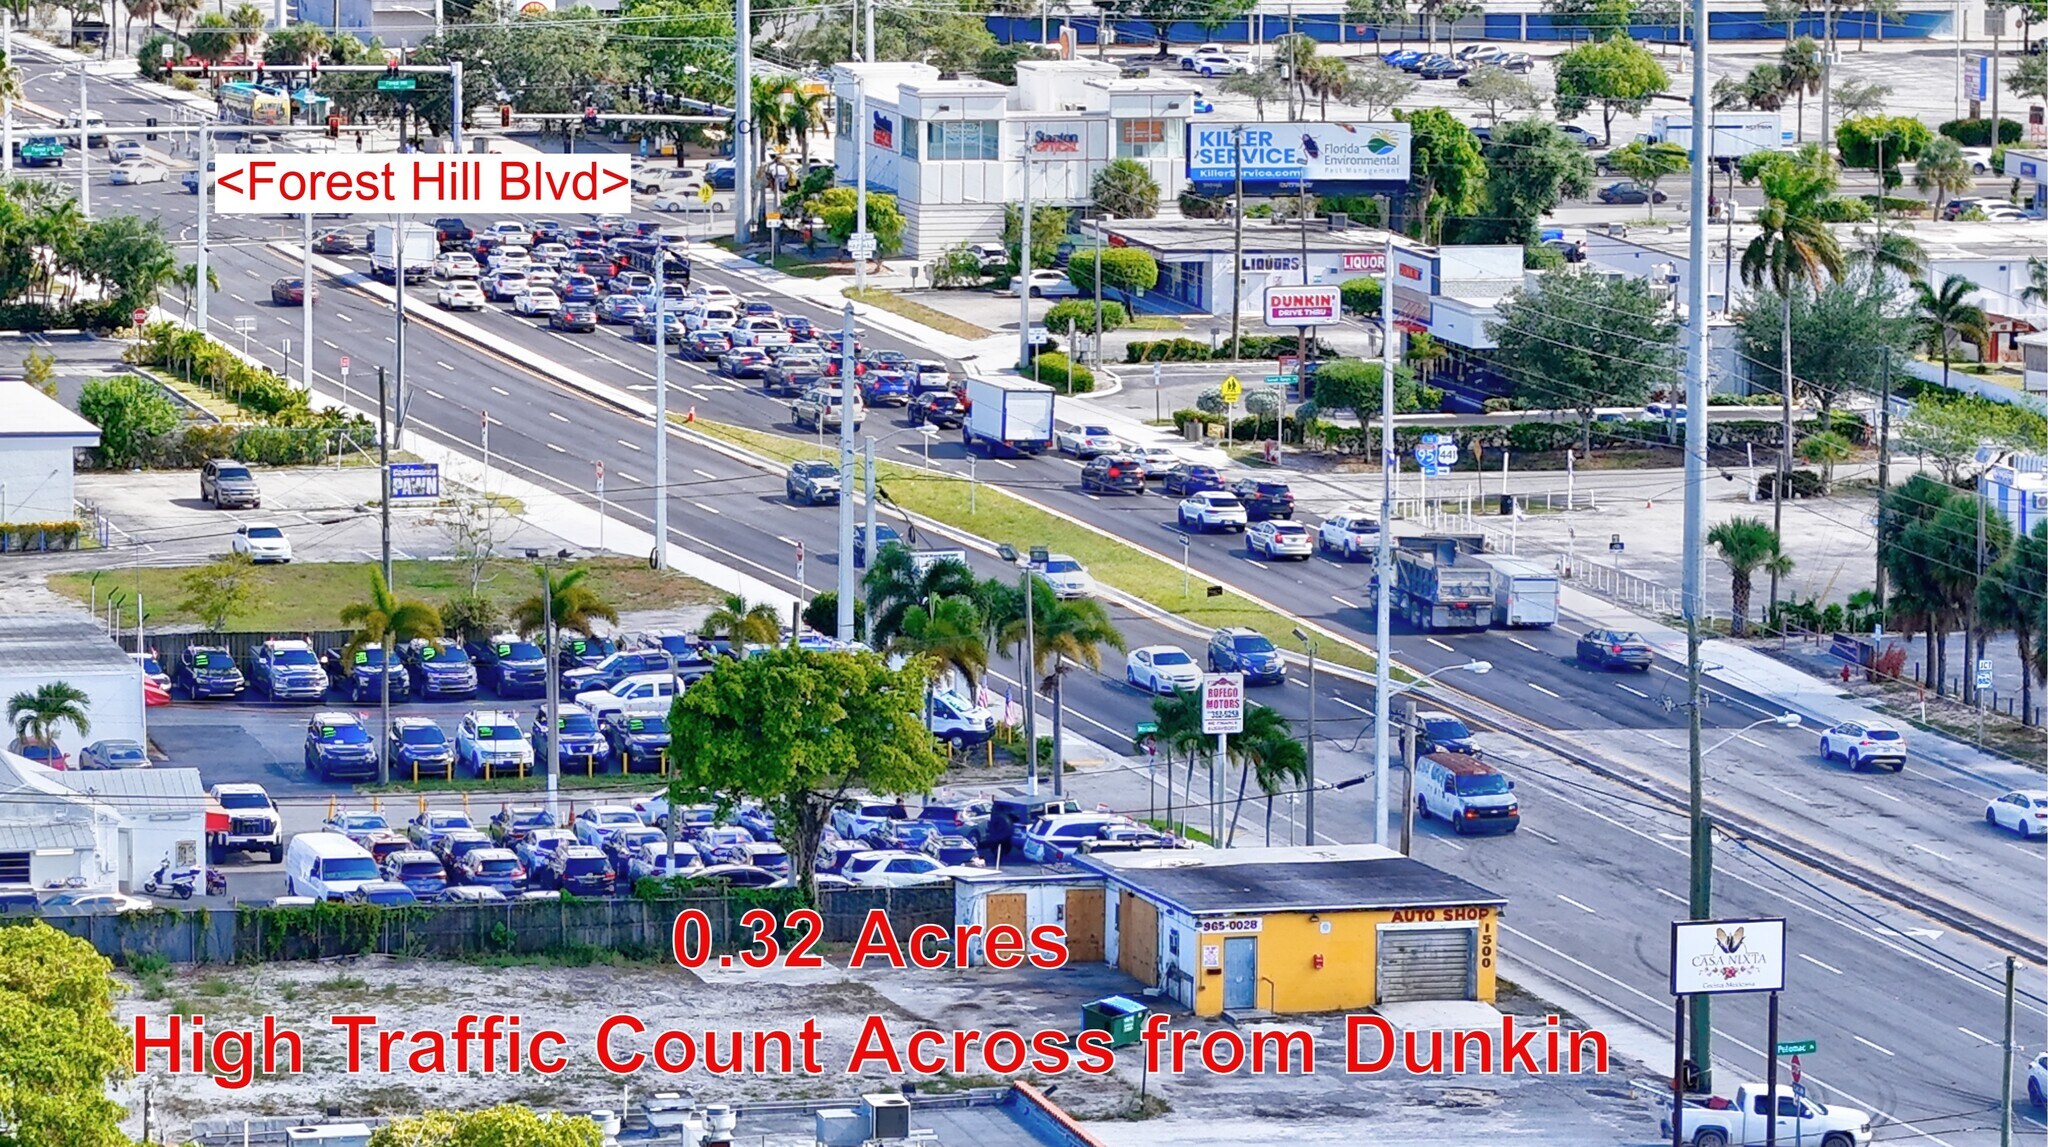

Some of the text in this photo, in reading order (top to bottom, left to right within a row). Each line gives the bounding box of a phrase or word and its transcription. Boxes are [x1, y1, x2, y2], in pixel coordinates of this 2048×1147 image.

[1324, 143, 1360, 154] Florida
[1324, 155, 1400, 166] Environmental
[1200, 169, 1301, 178] KillerSrvice.com
[1242, 256, 1300, 271] LIQUORS
[1343, 254, 1386, 269] LIQUOR
[1271, 294, 1336, 307] DUNKIN'
[1303, 308, 1327, 316] THRU
[1418, 449, 1456, 462] 95 441
[392, 476, 437, 495] PAWN
[1980, 661, 1992, 669] JCT
[1207, 687, 1239, 698] ROFEGO
[1206, 699, 1240, 709] MOTORS
[1391, 907, 1490, 923] AUTO SHOP
[1203, 919, 1258, 932] 965-0028
[1481, 923, 1492, 968] 1500
[1691, 953, 1767, 968] CASA NIXTA
